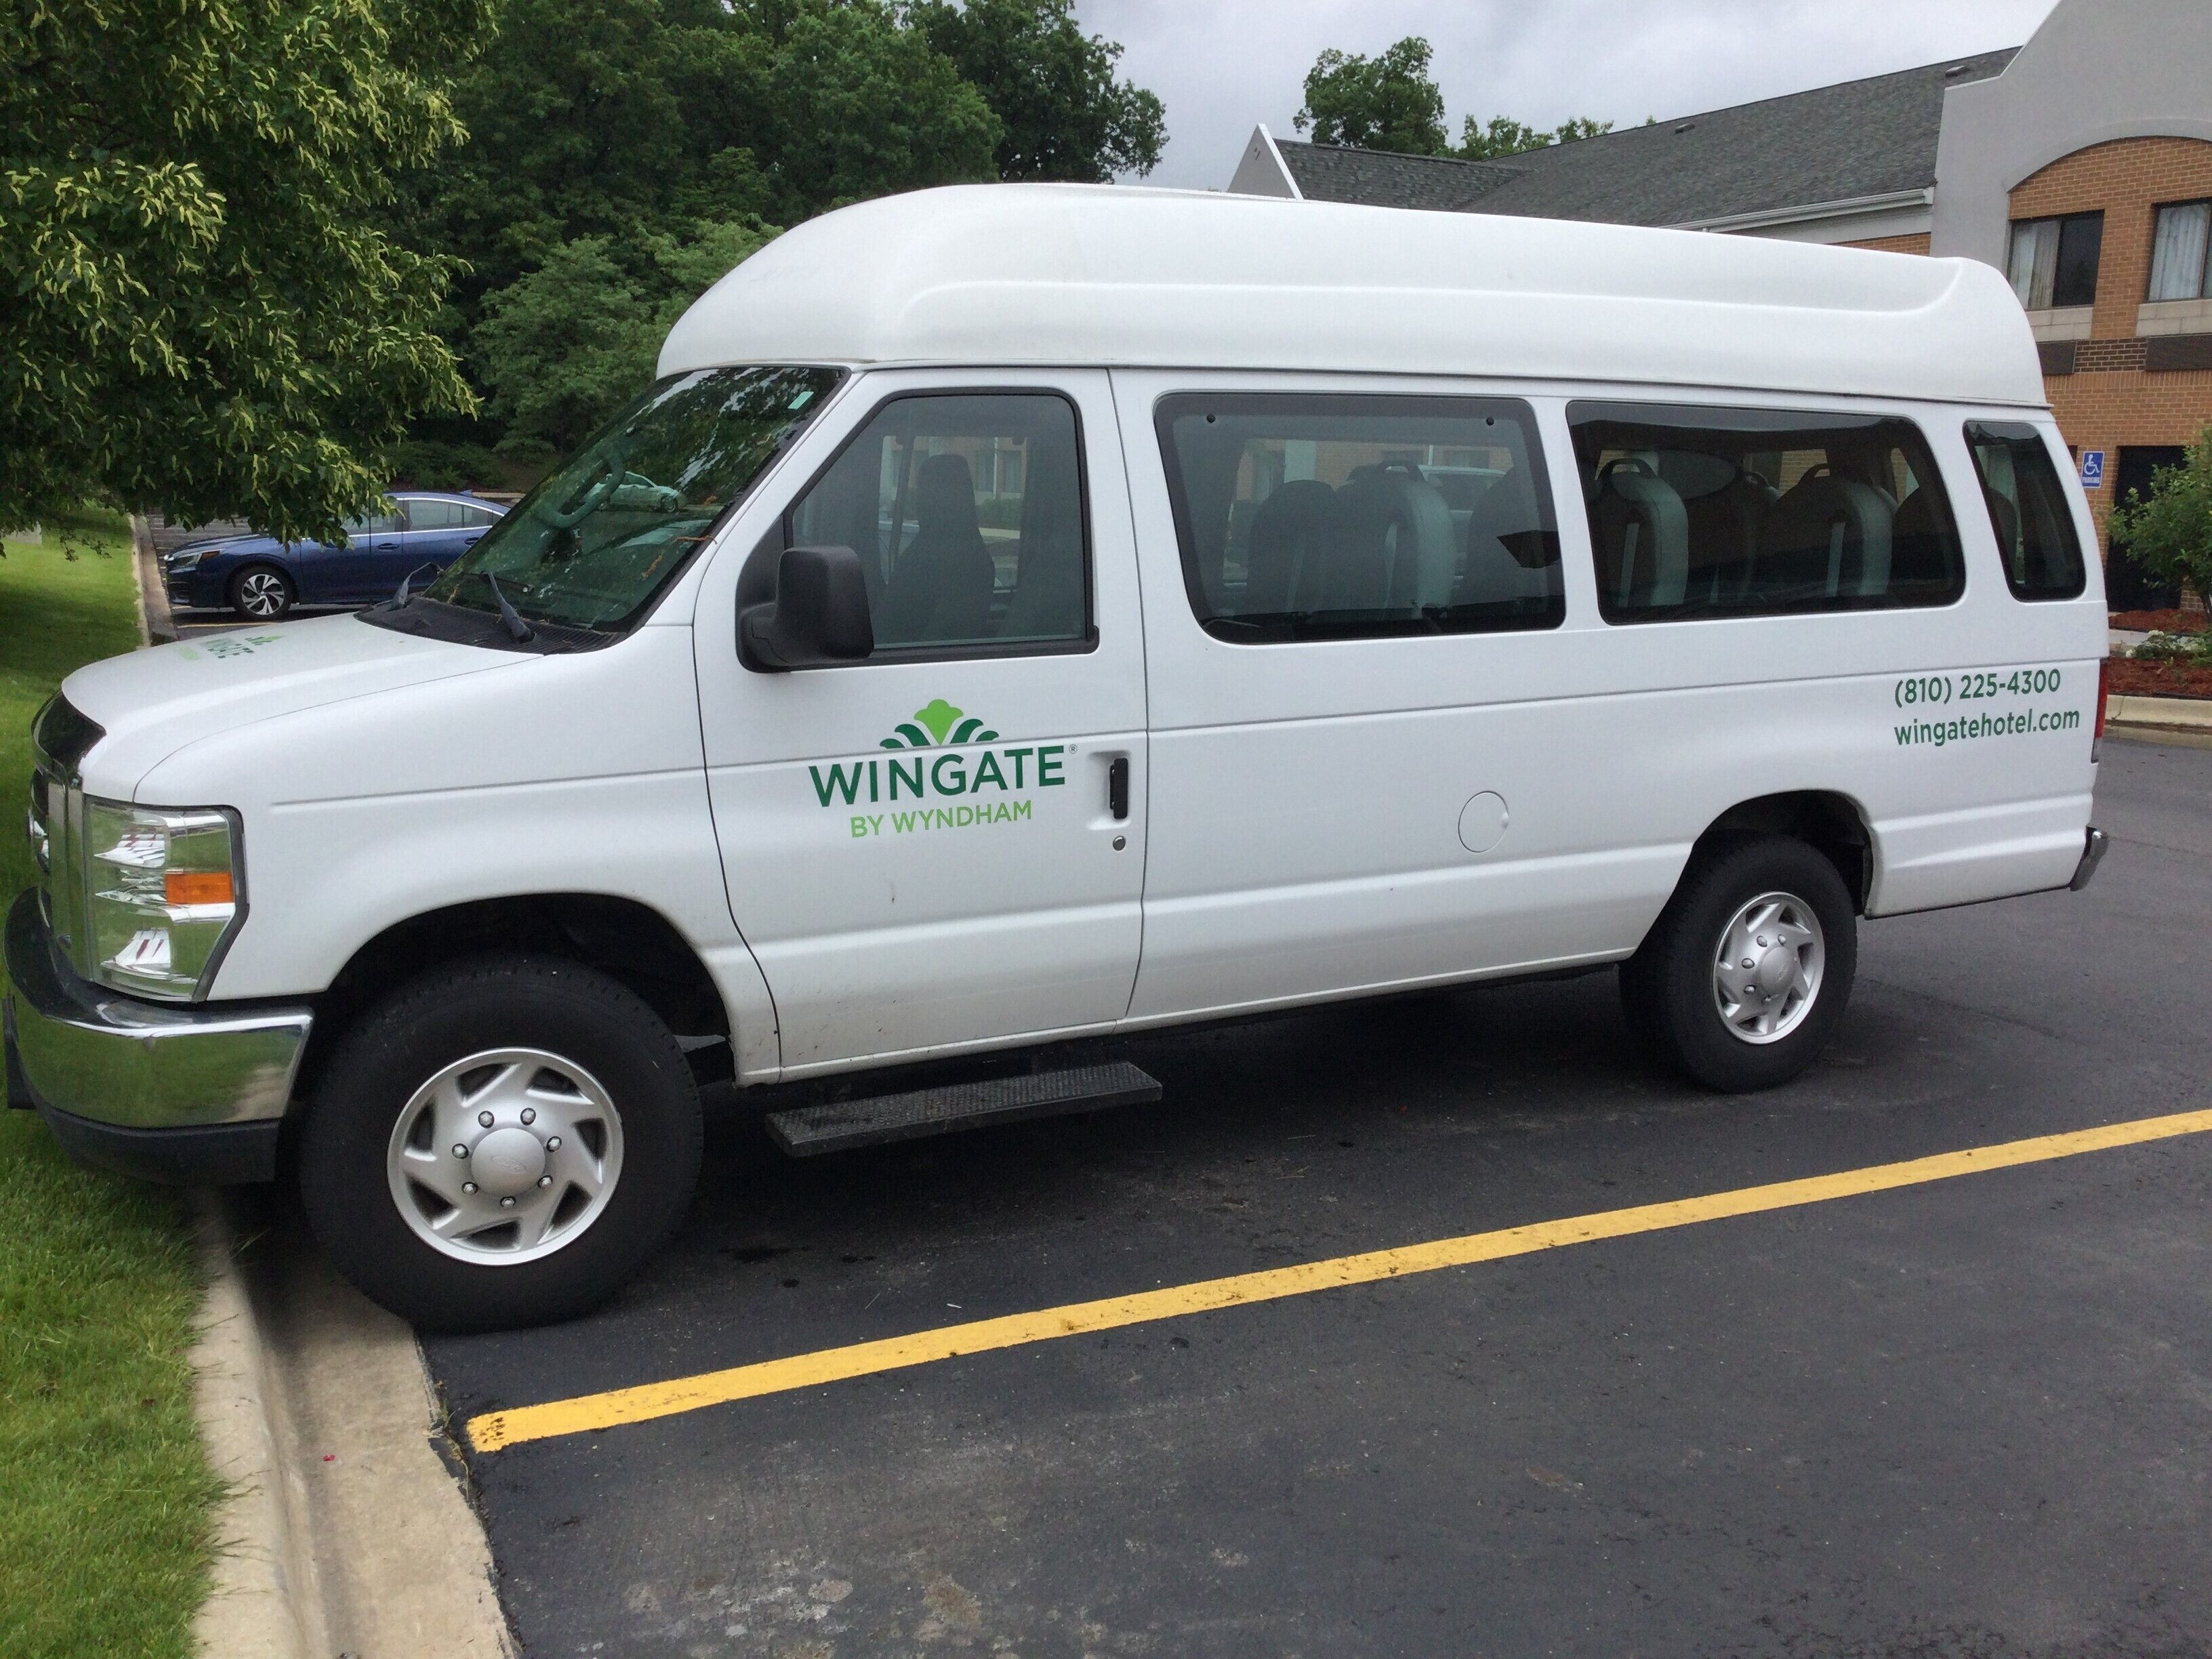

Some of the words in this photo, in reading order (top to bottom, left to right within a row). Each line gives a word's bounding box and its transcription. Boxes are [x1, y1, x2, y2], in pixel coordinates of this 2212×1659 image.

[1895, 676, 1952, 708] (810)
[1959, 668, 2061, 699] 225-4300
[1893, 708, 2080, 747] wingatehotel.com
[808, 745, 1066, 807] WINGATE
[850, 815, 884, 838] BY
[890, 800, 1032, 834] WYNDHAM
